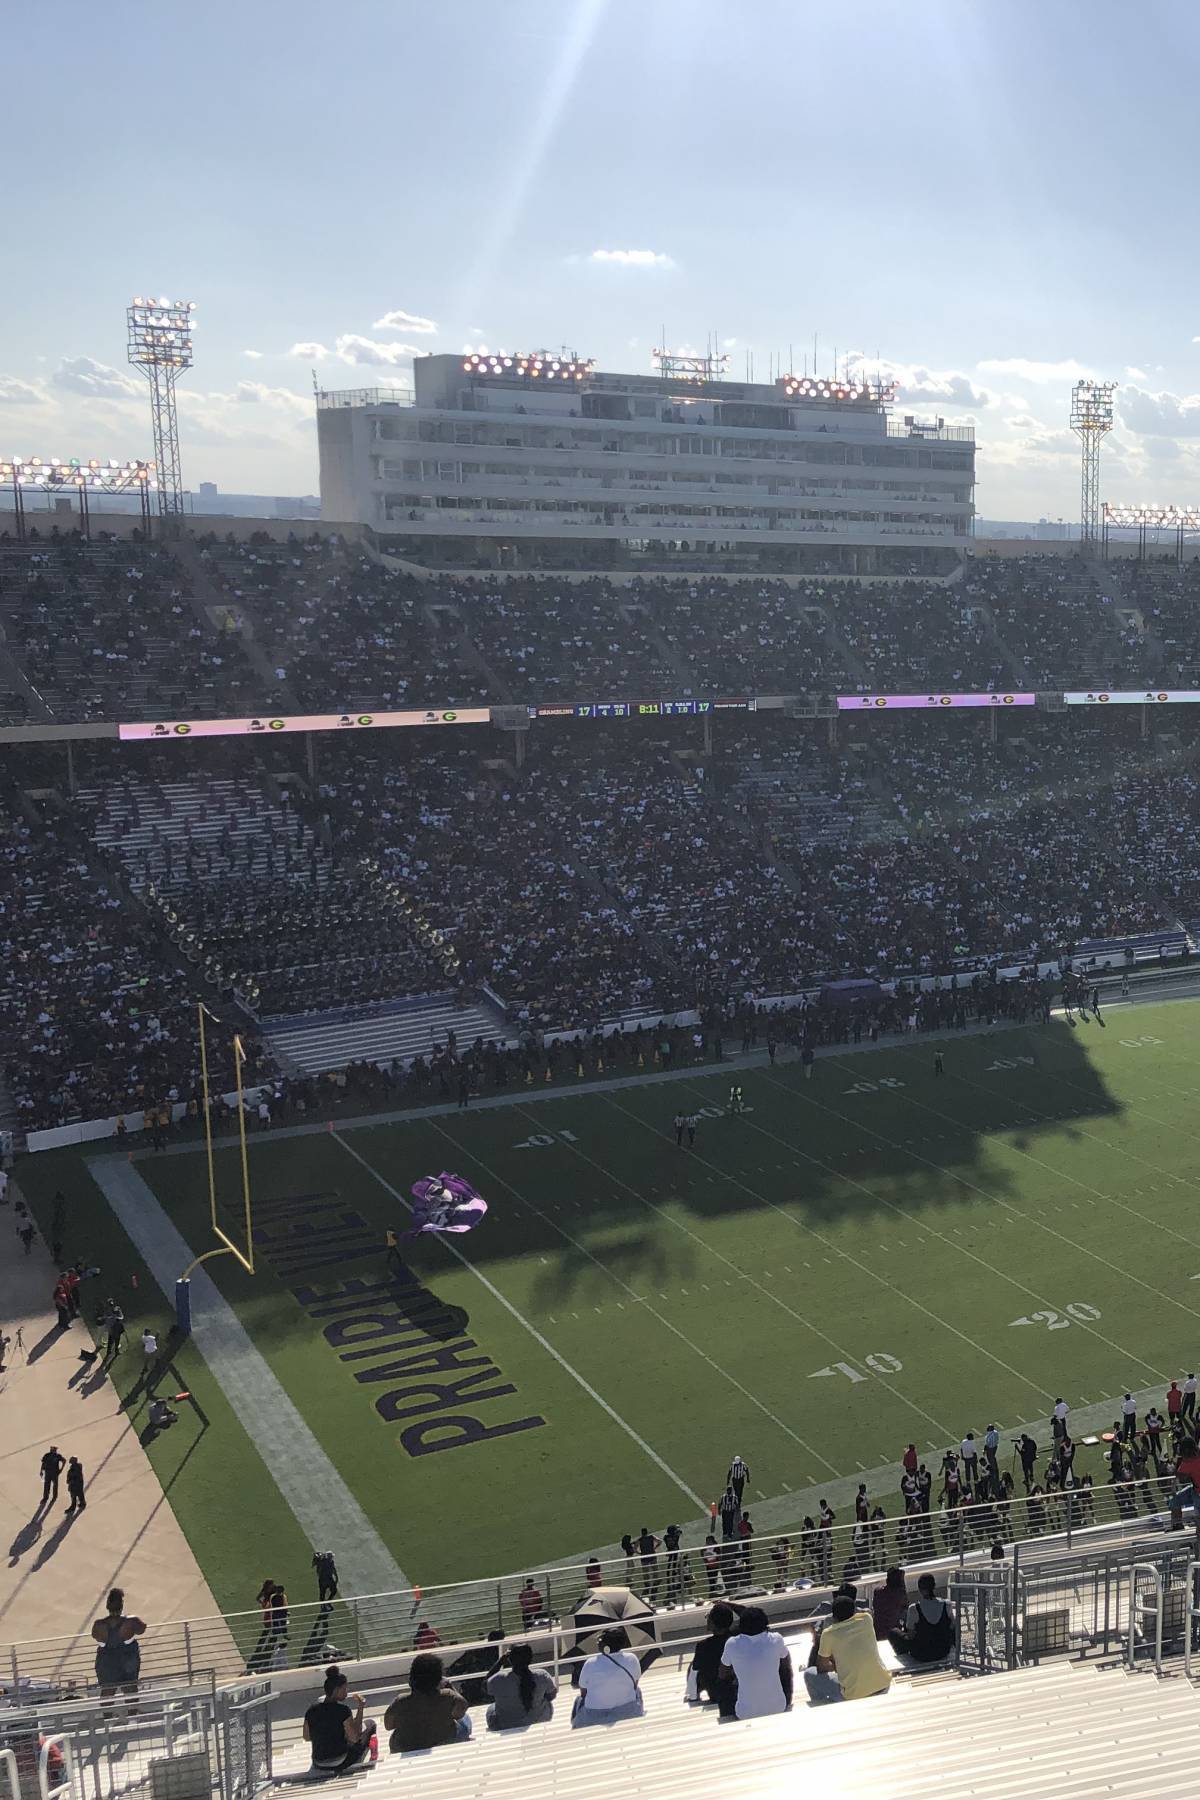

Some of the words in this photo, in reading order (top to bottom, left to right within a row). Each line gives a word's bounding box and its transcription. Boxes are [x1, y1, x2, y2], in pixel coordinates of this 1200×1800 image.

[579, 707, 590, 716] 17
[639, 705, 659, 714] 8:11
[699, 703, 709, 711] 17
[1030, 1301, 1102, 1330] 20
[292, 1264, 547, 1458] PRAIRIE
[830, 1352, 904, 1383] 10
